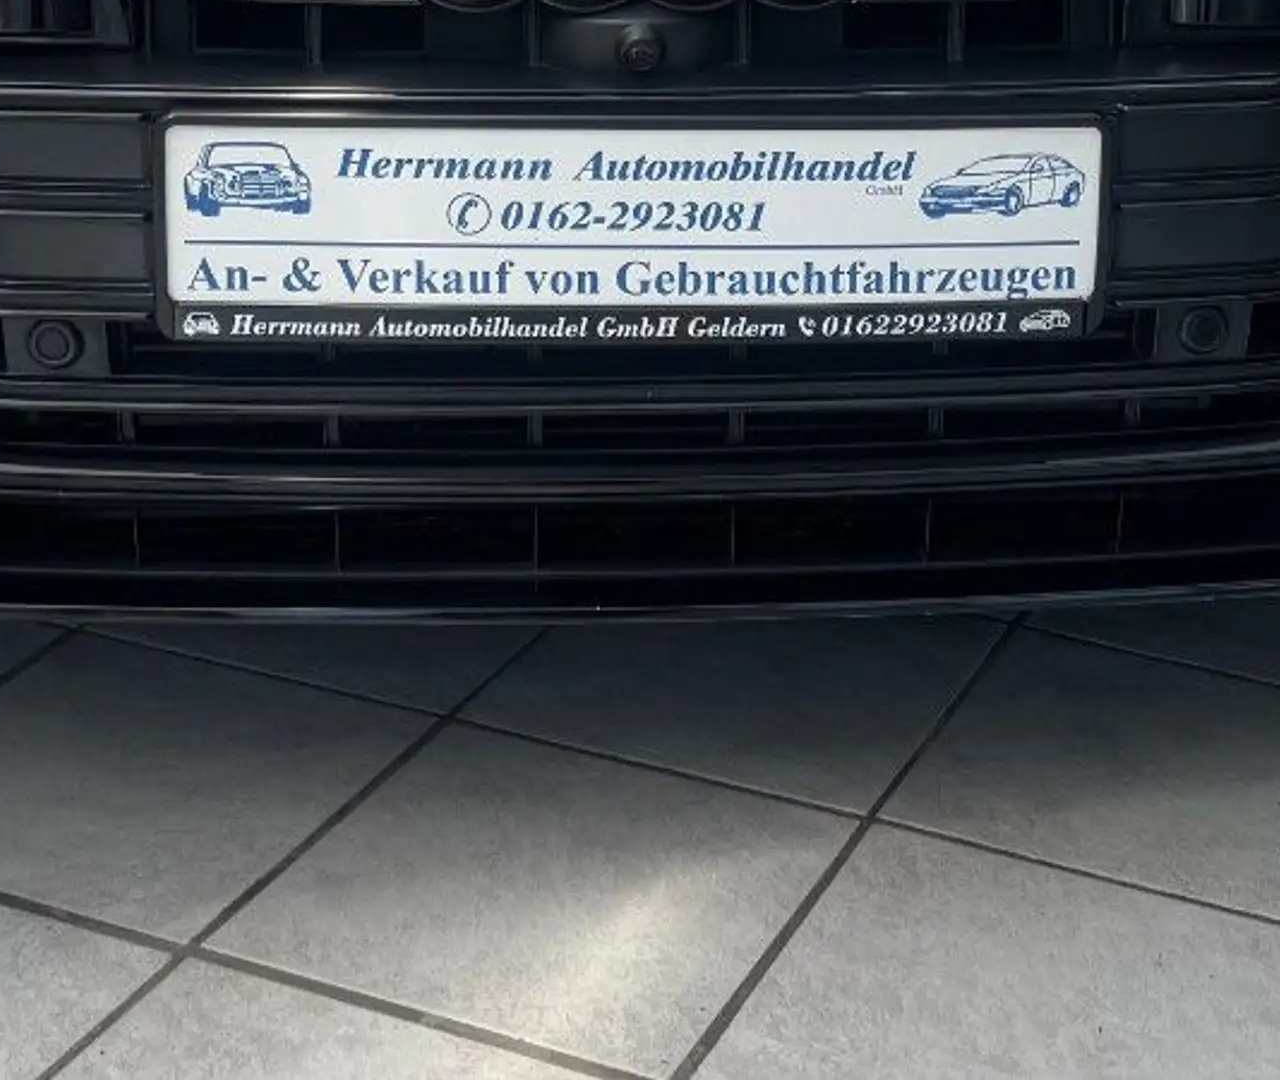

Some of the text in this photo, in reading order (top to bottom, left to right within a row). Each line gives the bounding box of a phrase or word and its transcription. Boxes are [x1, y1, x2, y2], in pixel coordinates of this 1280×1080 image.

[336, 148, 917, 182] Herrmann Automobilhandel
[500, 201, 765, 232] 0162-2923081
[188, 257, 1077, 300] An- & Verkauf von Gebrauchtfahrzeugen
[229, 311, 1007, 339] Herrmann Automobilhandel GmbH Geldern 01622923081
